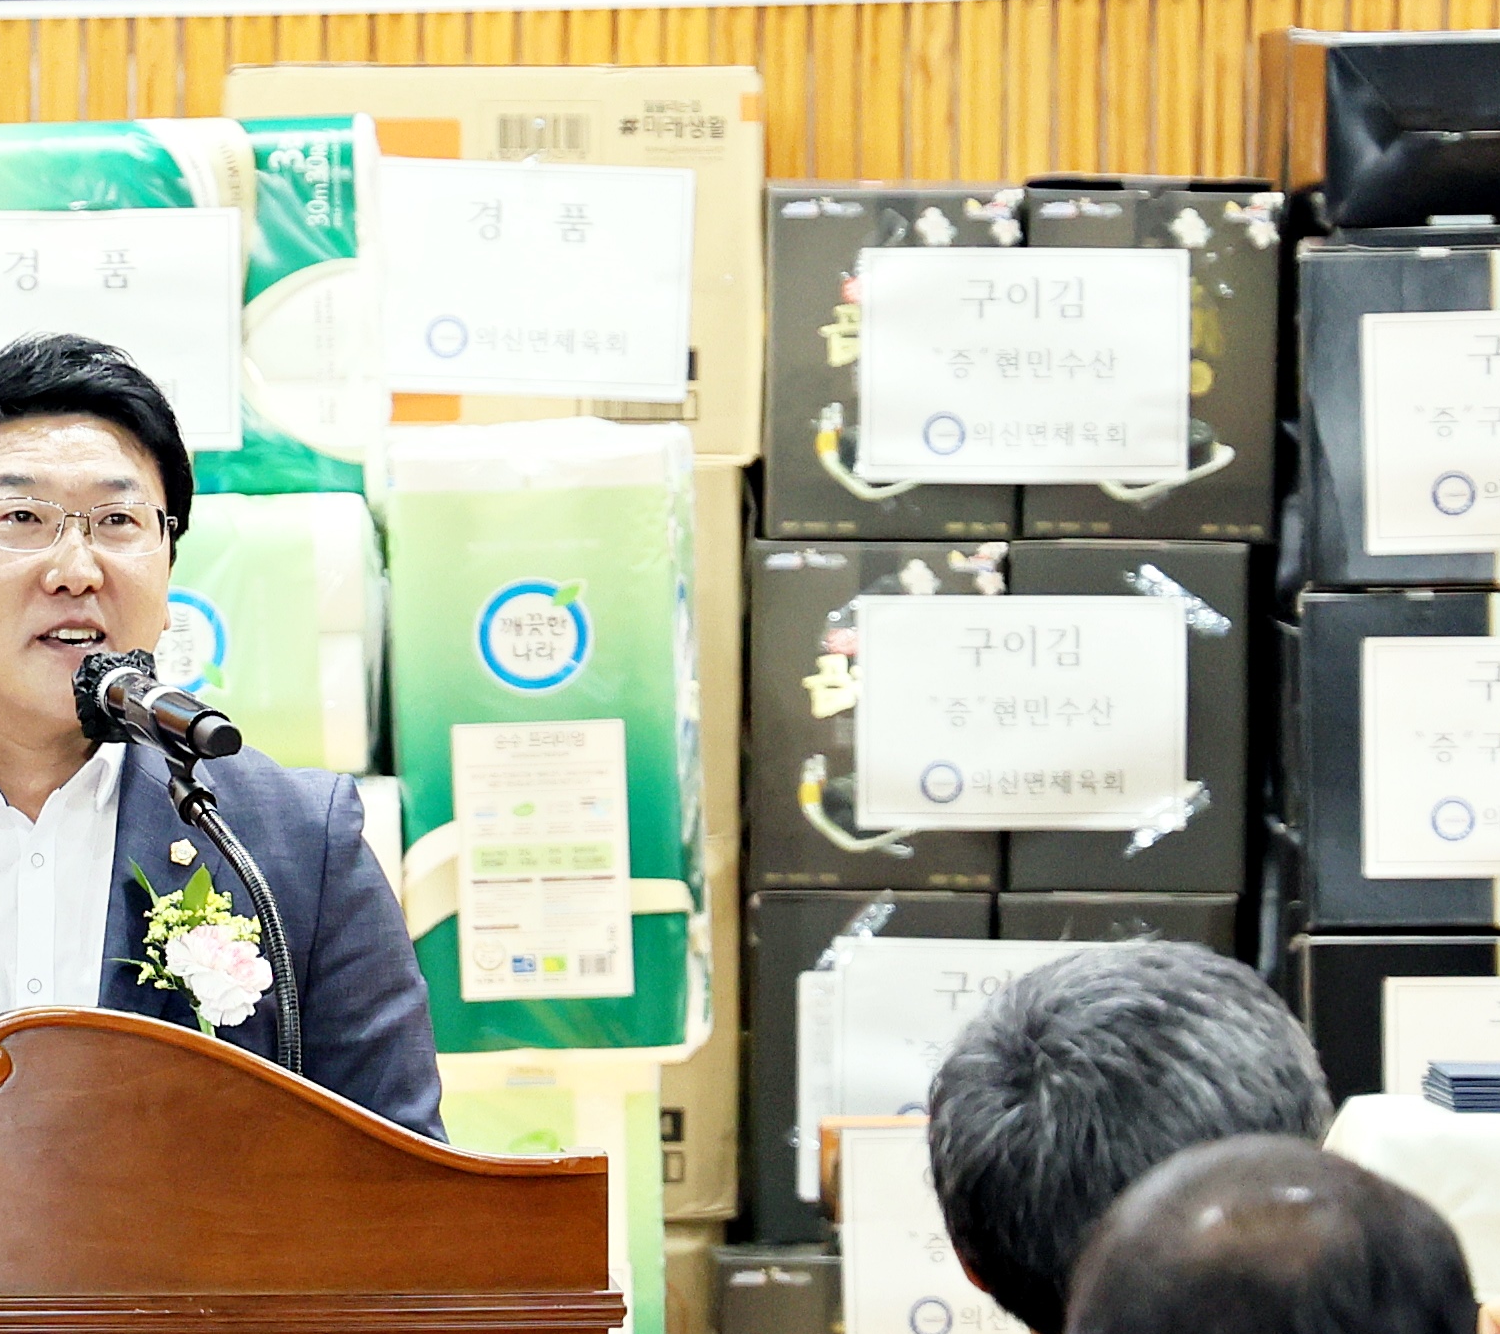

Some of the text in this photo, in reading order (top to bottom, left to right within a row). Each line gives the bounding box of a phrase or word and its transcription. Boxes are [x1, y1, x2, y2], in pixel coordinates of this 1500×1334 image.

[960, 277, 1085, 319] 구이김
[972, 421, 1128, 448] 의신면체육회
[955, 624, 1081, 668] 구이김
[971, 768, 1125, 796] 의신면체육회
